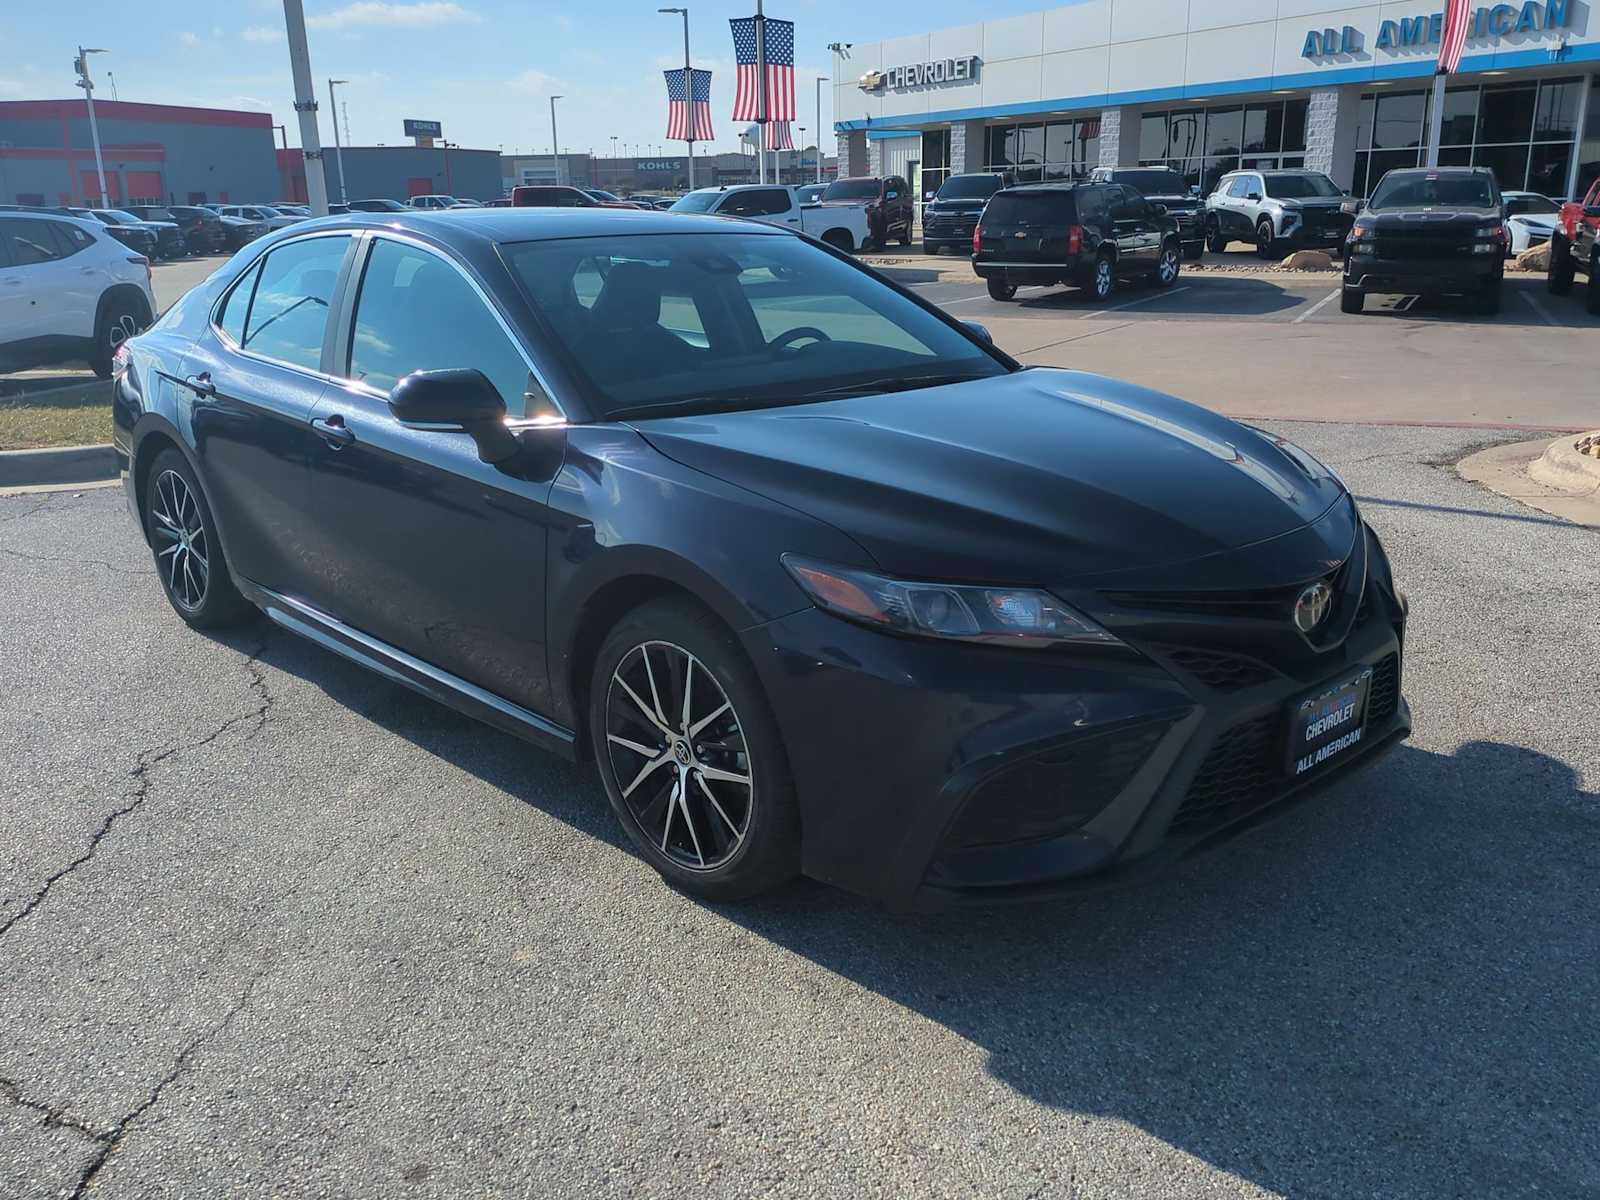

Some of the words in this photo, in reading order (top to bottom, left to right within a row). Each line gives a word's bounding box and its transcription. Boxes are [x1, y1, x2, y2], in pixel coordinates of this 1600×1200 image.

[1301, 25, 1364, 58] ALL
[1375, 0, 1570, 48] AMEICAN
[886, 56, 976, 88] CHEVROLET
[1305, 702, 1355, 741] CHEVROLET
[1295, 754, 1314, 775] ALL
[1315, 728, 1361, 764] AMERICAN
